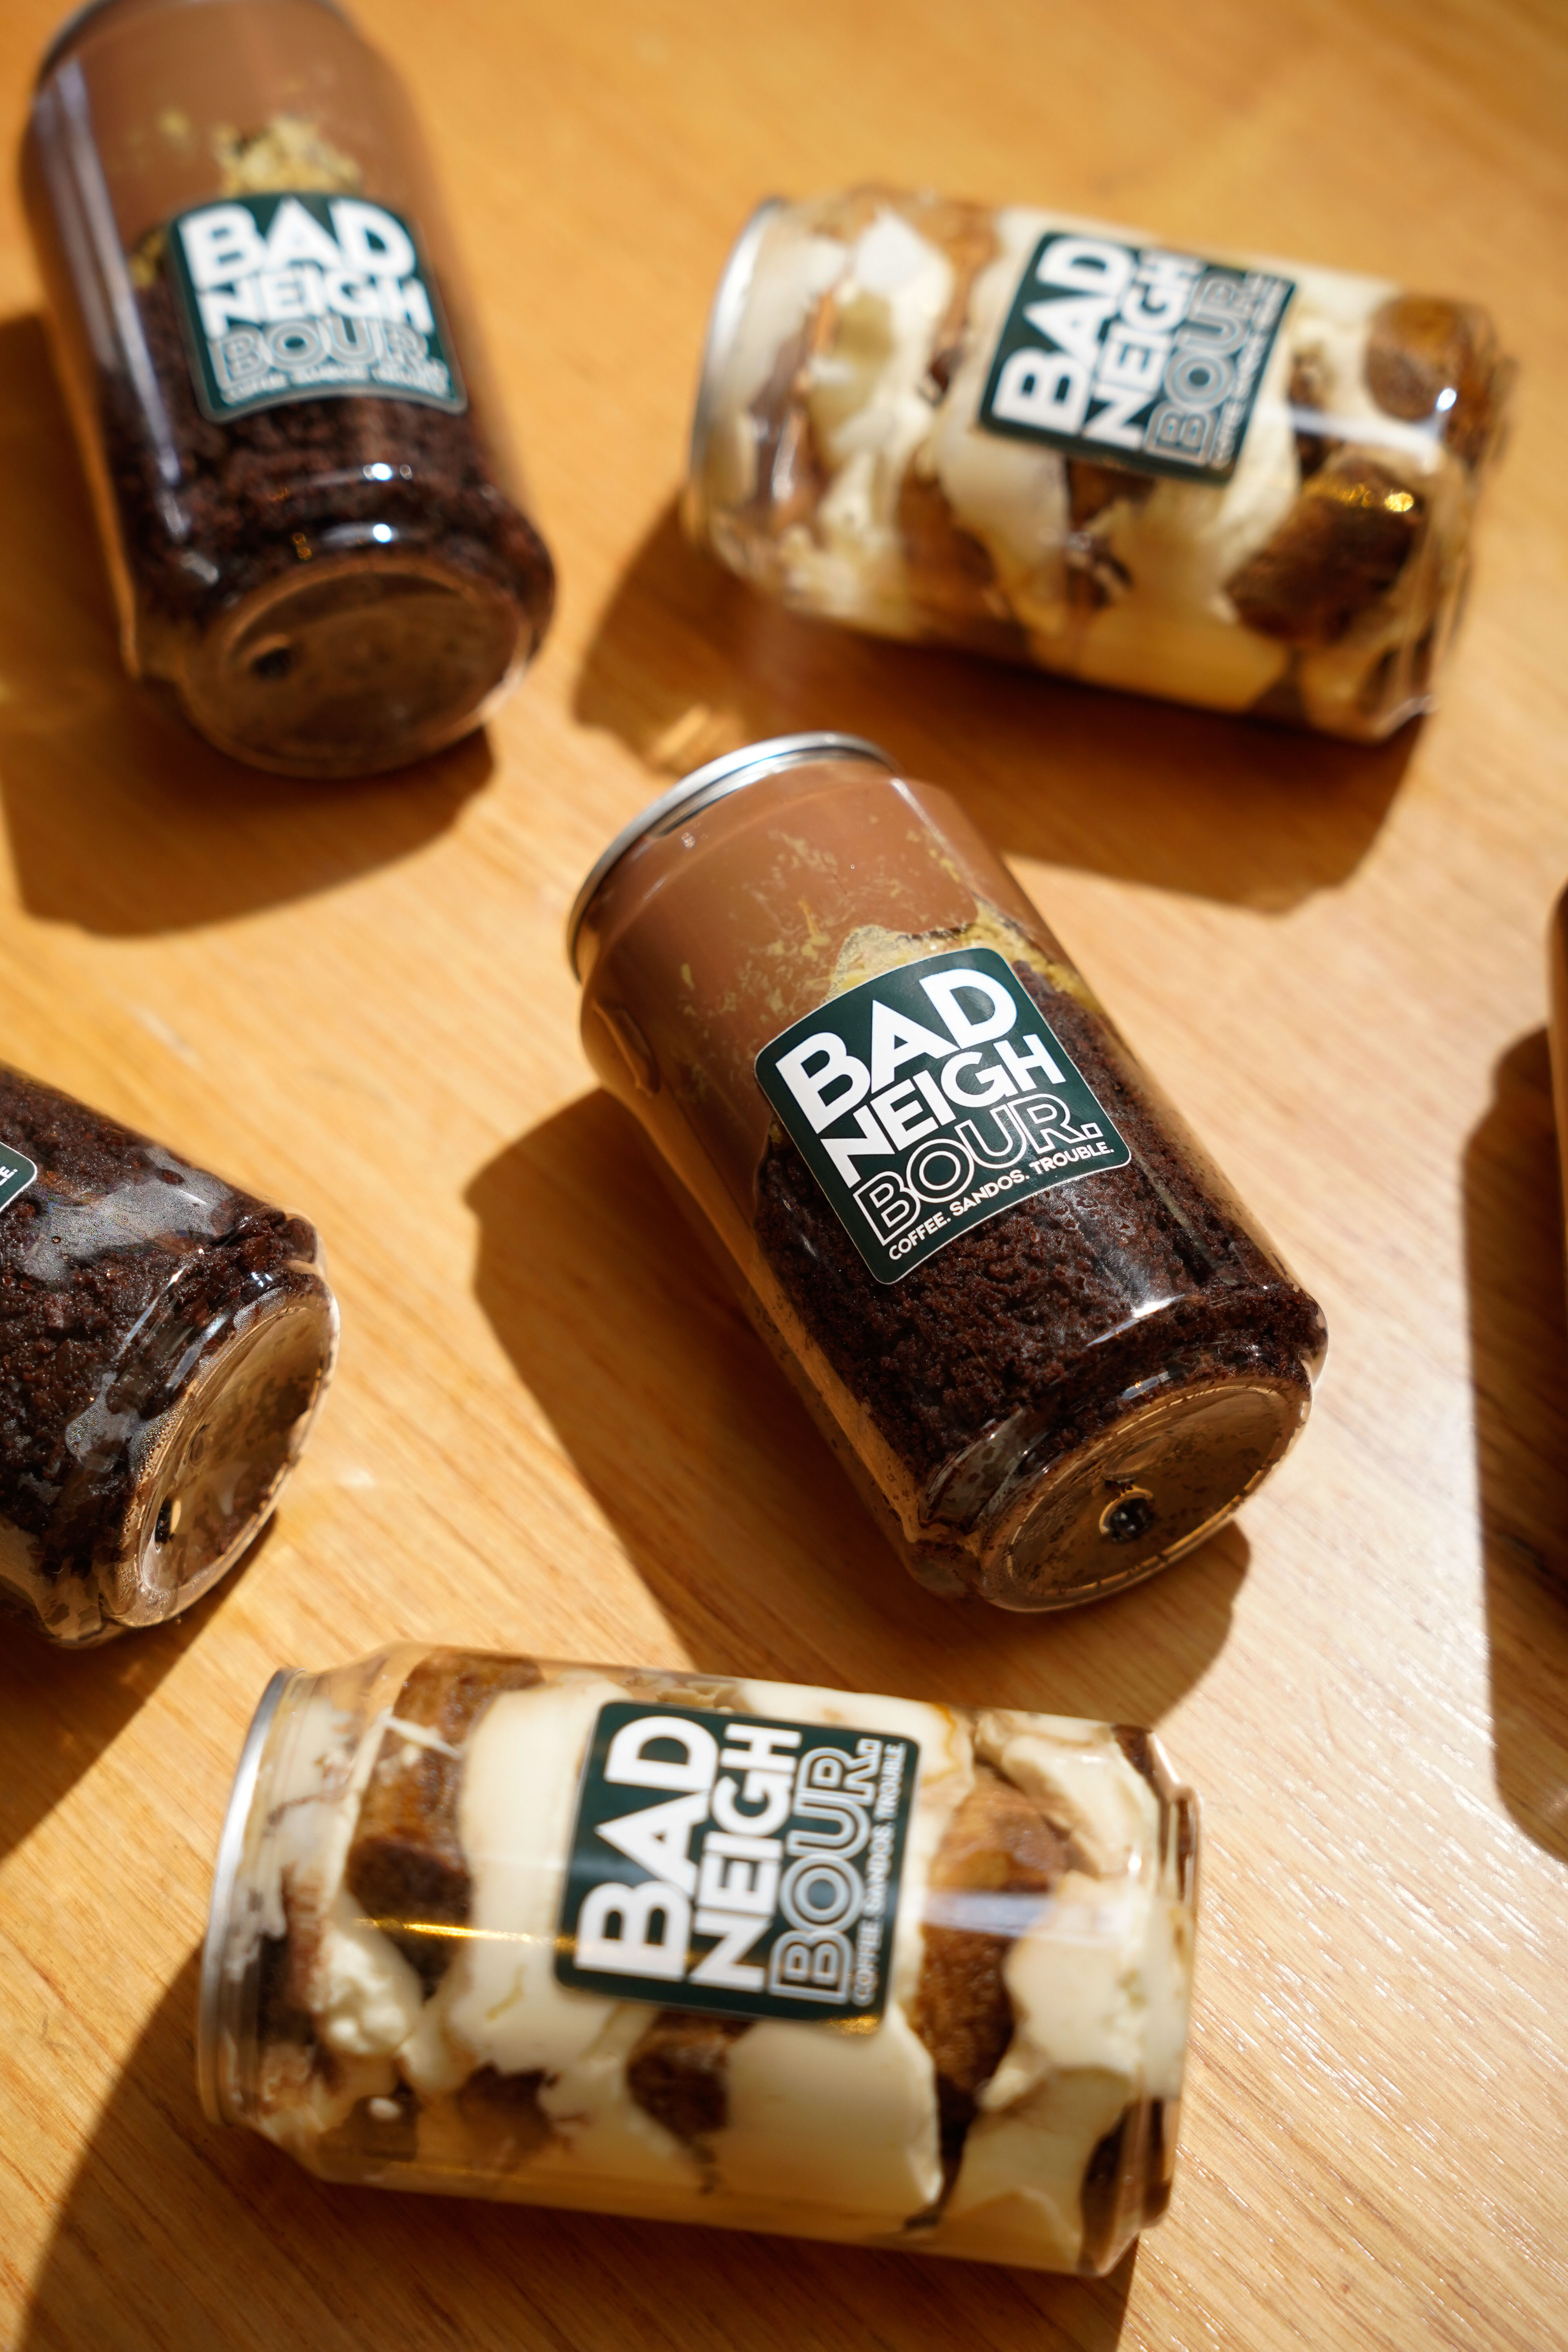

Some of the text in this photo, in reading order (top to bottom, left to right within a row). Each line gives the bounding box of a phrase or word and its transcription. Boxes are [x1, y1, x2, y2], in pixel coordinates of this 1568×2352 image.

[177, 196, 416, 291] BAD
[196, 267, 435, 340] NEIGH
[990, 236, 1136, 436] BAD
[1081, 248, 1203, 451] NEIGH
[775, 968, 1017, 1134] BAD
[820, 1034, 1066, 1188] NEIGH
[853, 1093, 1103, 1246] BOUR.
[888, 1141, 1115, 1260] COFFEE. SANDOS. TROUBLE.
[573, 1715, 719, 1982] BAD
[689, 1722, 802, 1993] NEIGH
